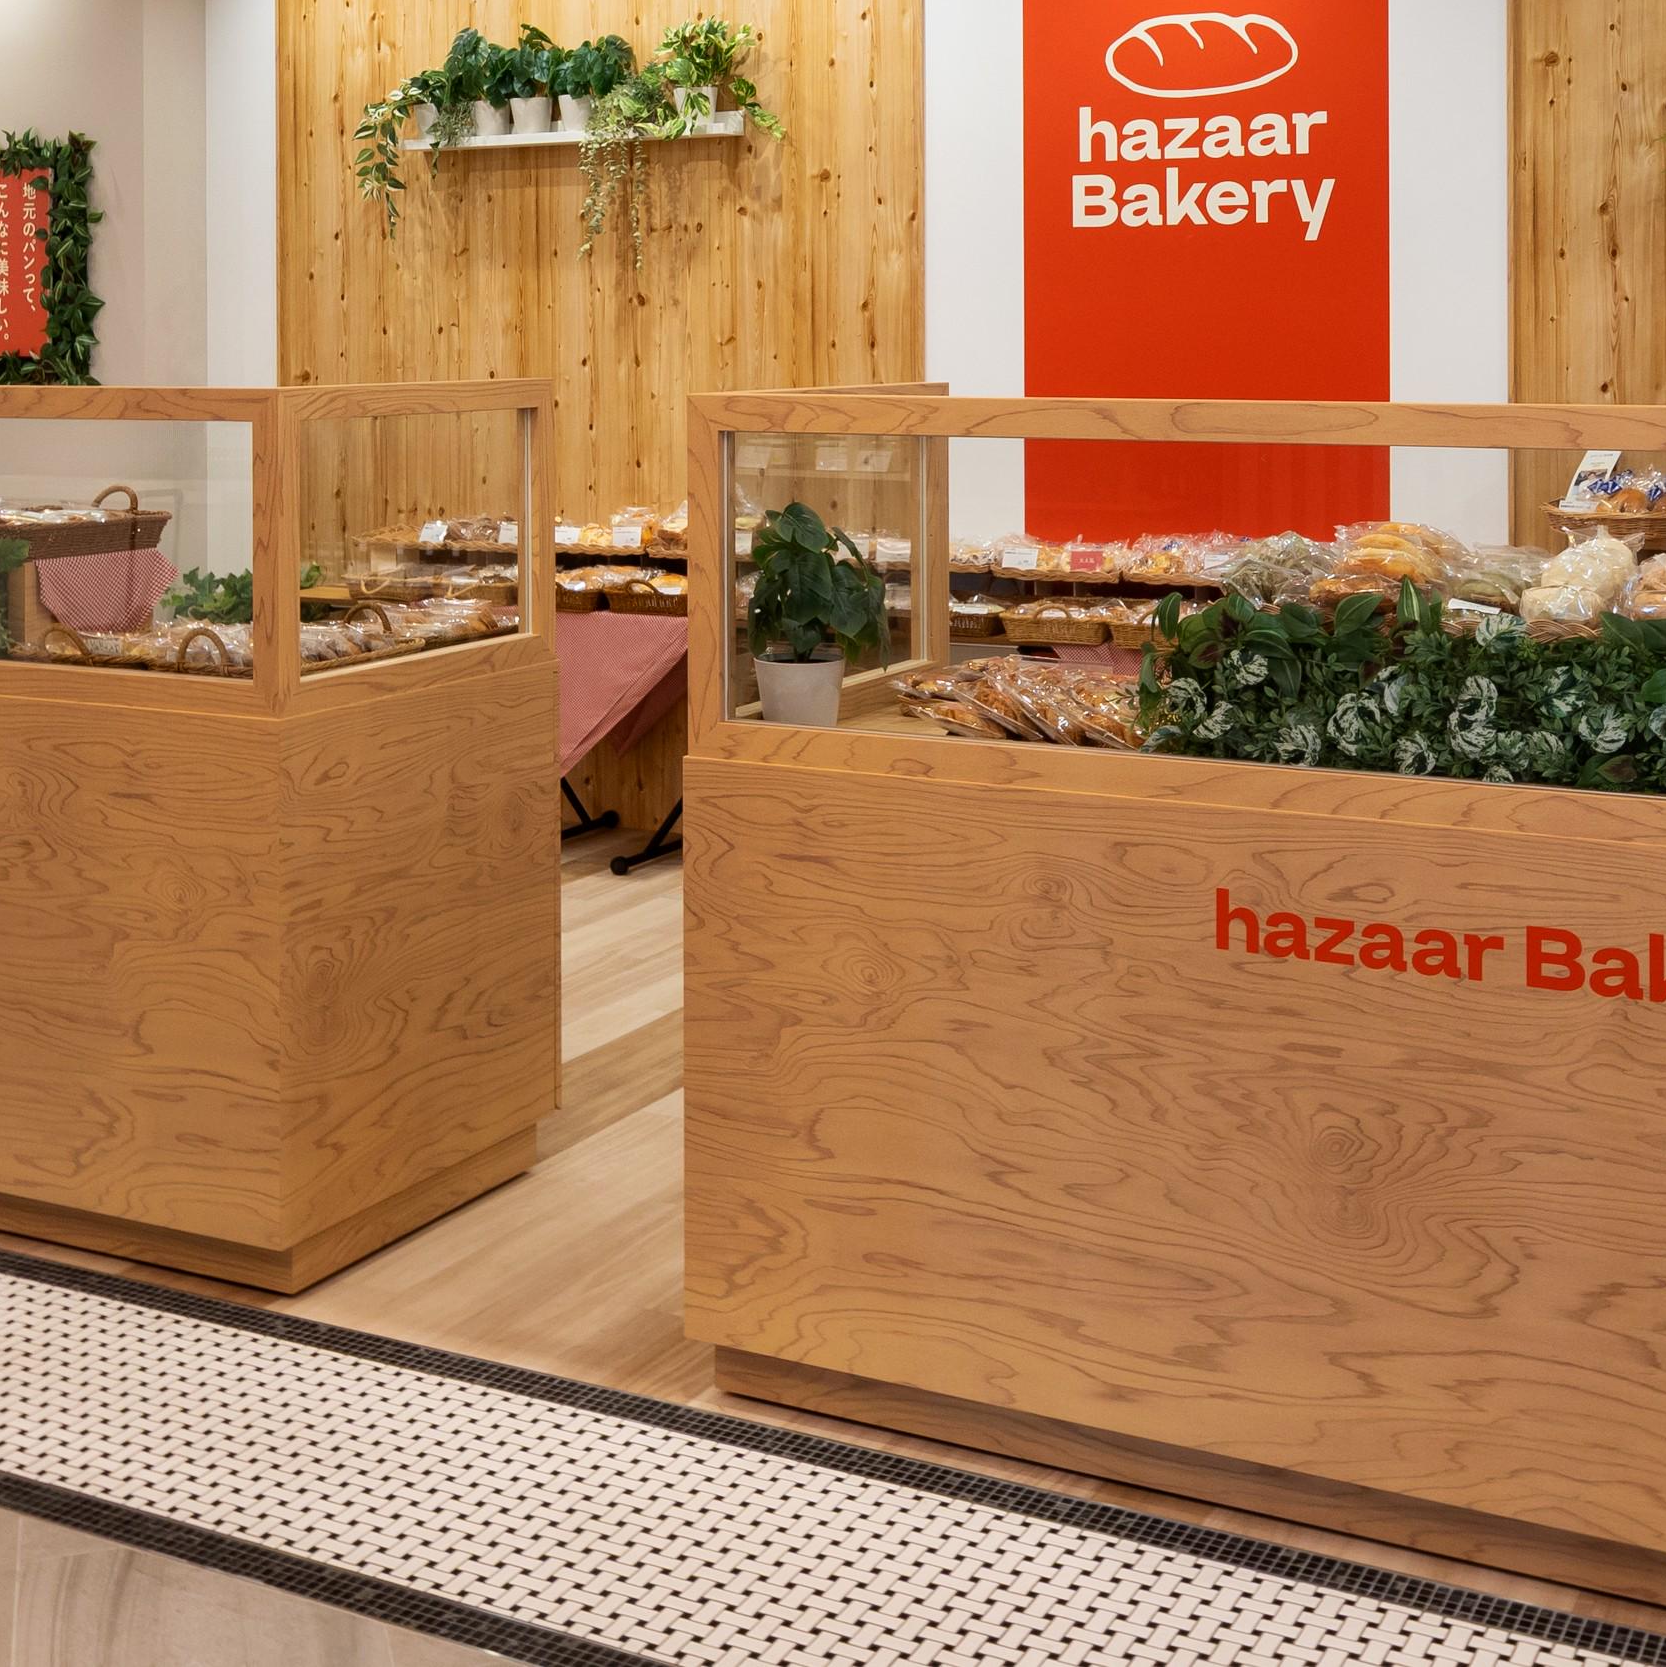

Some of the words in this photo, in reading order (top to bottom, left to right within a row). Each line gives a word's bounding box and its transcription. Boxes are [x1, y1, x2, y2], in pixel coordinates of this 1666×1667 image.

[1079, 106, 1328, 163] hazaar
[1071, 167, 1336, 241] Bakery
[22, 183, 36, 312] 地元のパンって、
[1215, 887, 1504, 981] hazaar
